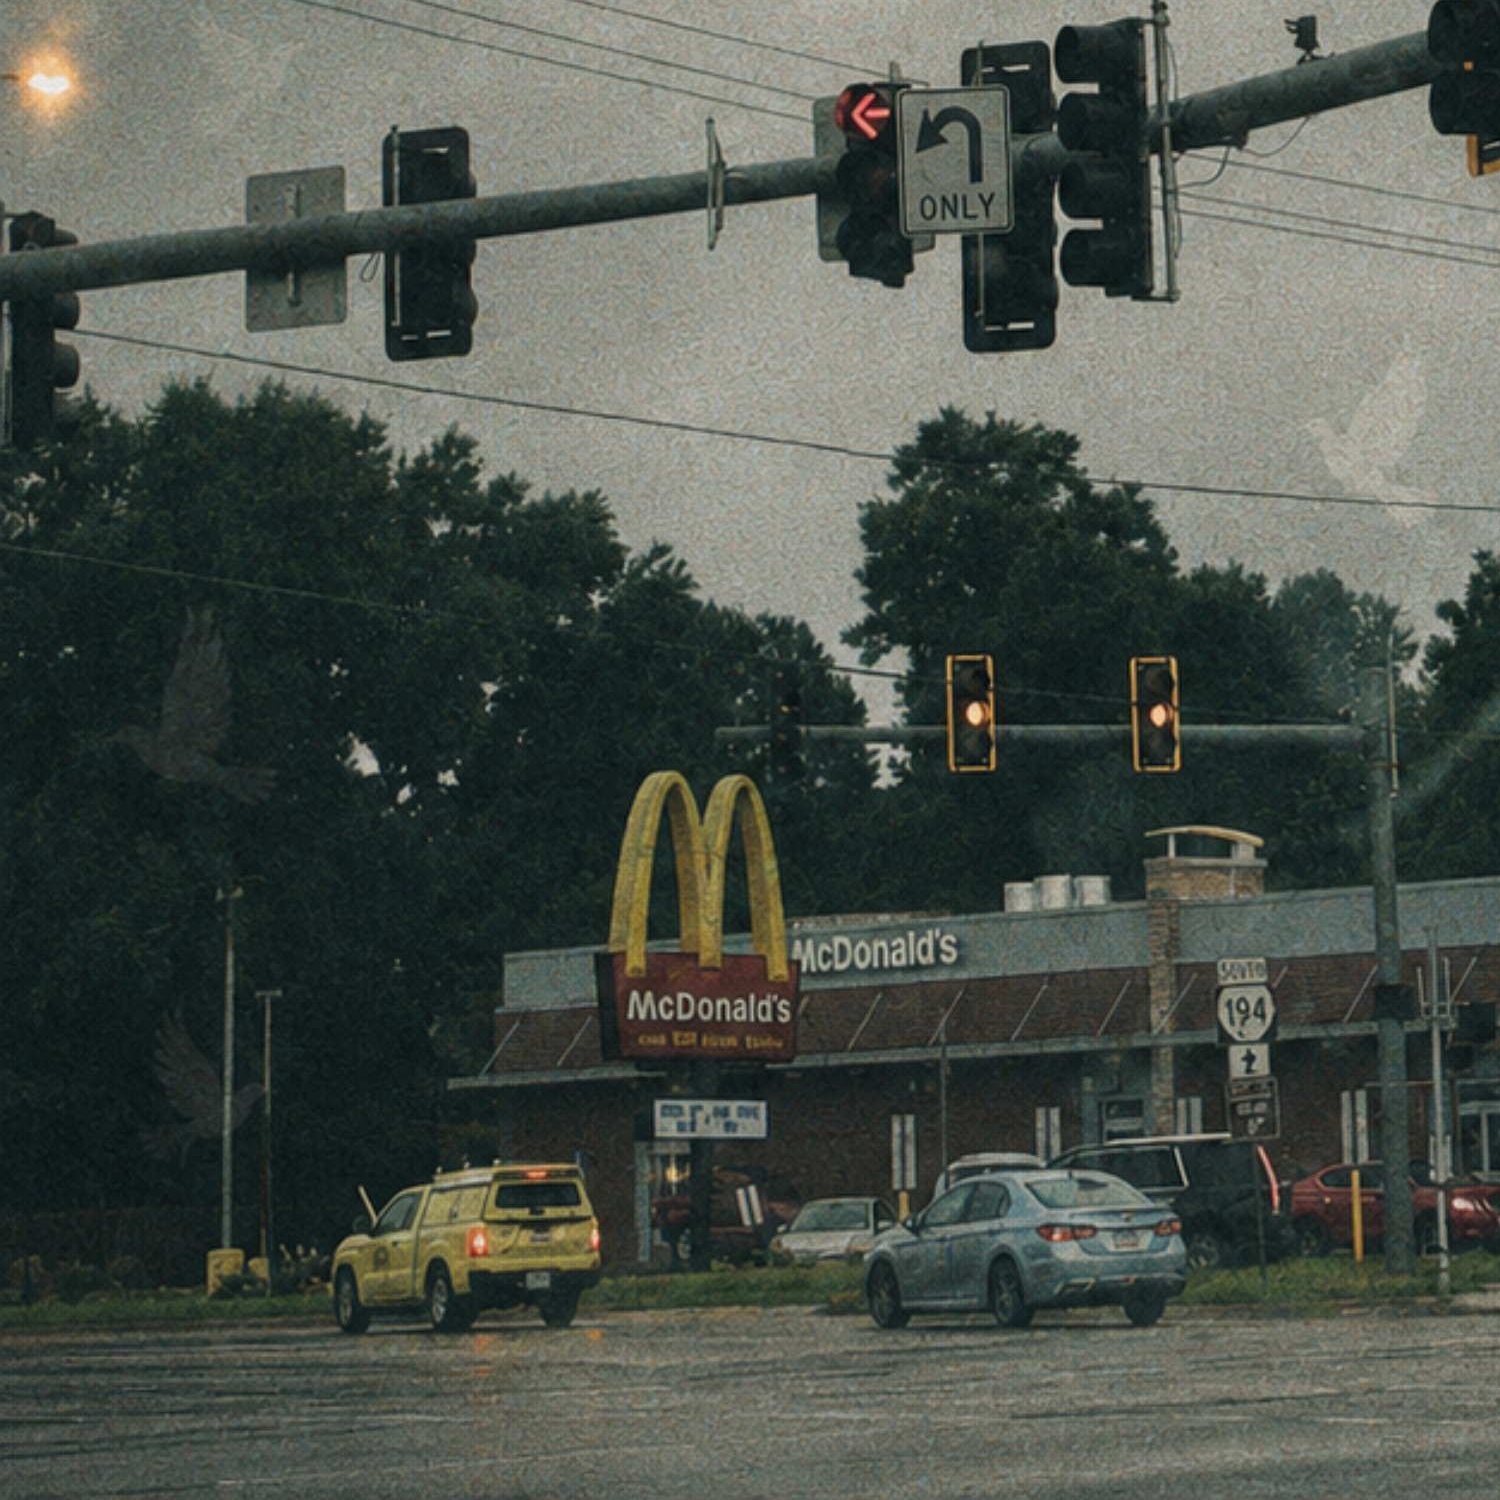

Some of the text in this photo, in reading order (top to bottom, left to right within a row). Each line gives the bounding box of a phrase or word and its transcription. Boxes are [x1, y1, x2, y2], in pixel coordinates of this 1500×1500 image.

[919, 190, 997, 222] ONLY
[791, 928, 959, 974] McDonald's
[626, 989, 792, 1024] McDonald's
[1224, 996, 1267, 1028] 194
